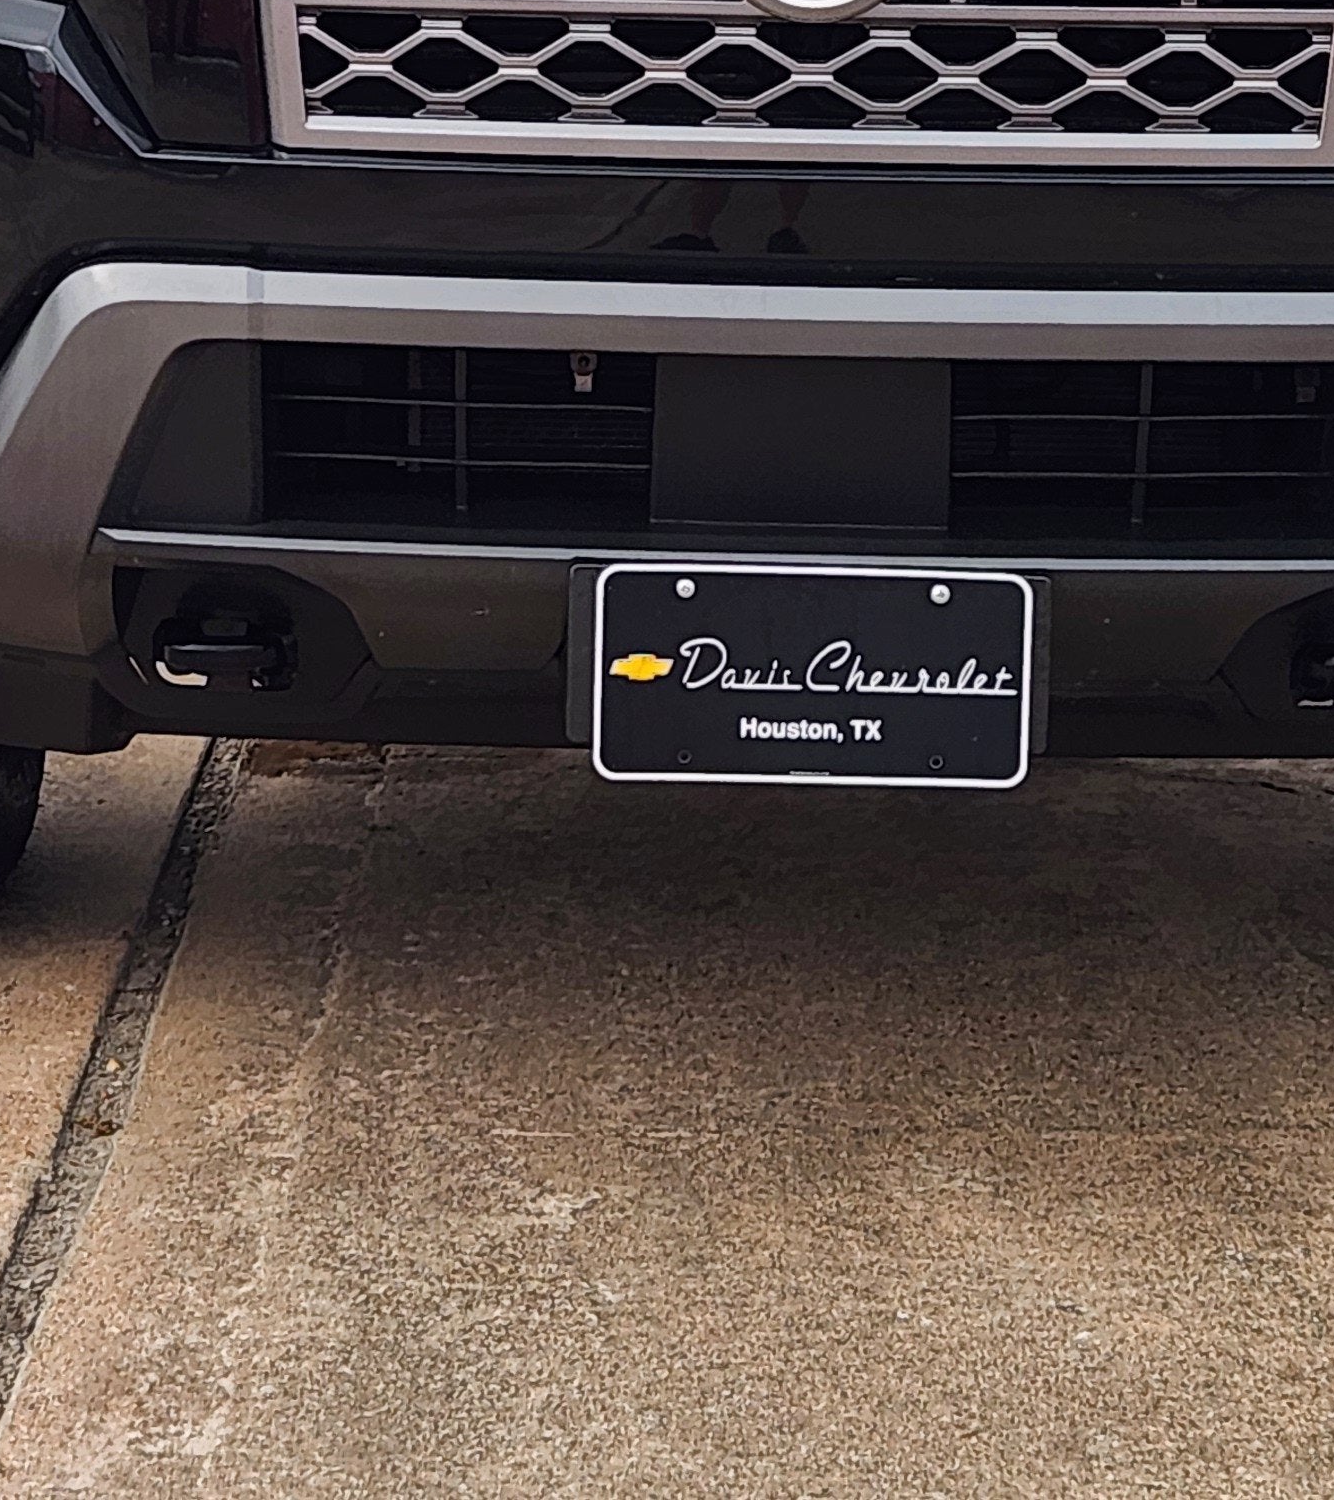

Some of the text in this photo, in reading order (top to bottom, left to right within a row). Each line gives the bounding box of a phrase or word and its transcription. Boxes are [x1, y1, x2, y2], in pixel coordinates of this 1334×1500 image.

[679, 636, 1018, 696] Davis Chevrolet
[739, 716, 883, 743] Houston, TX
